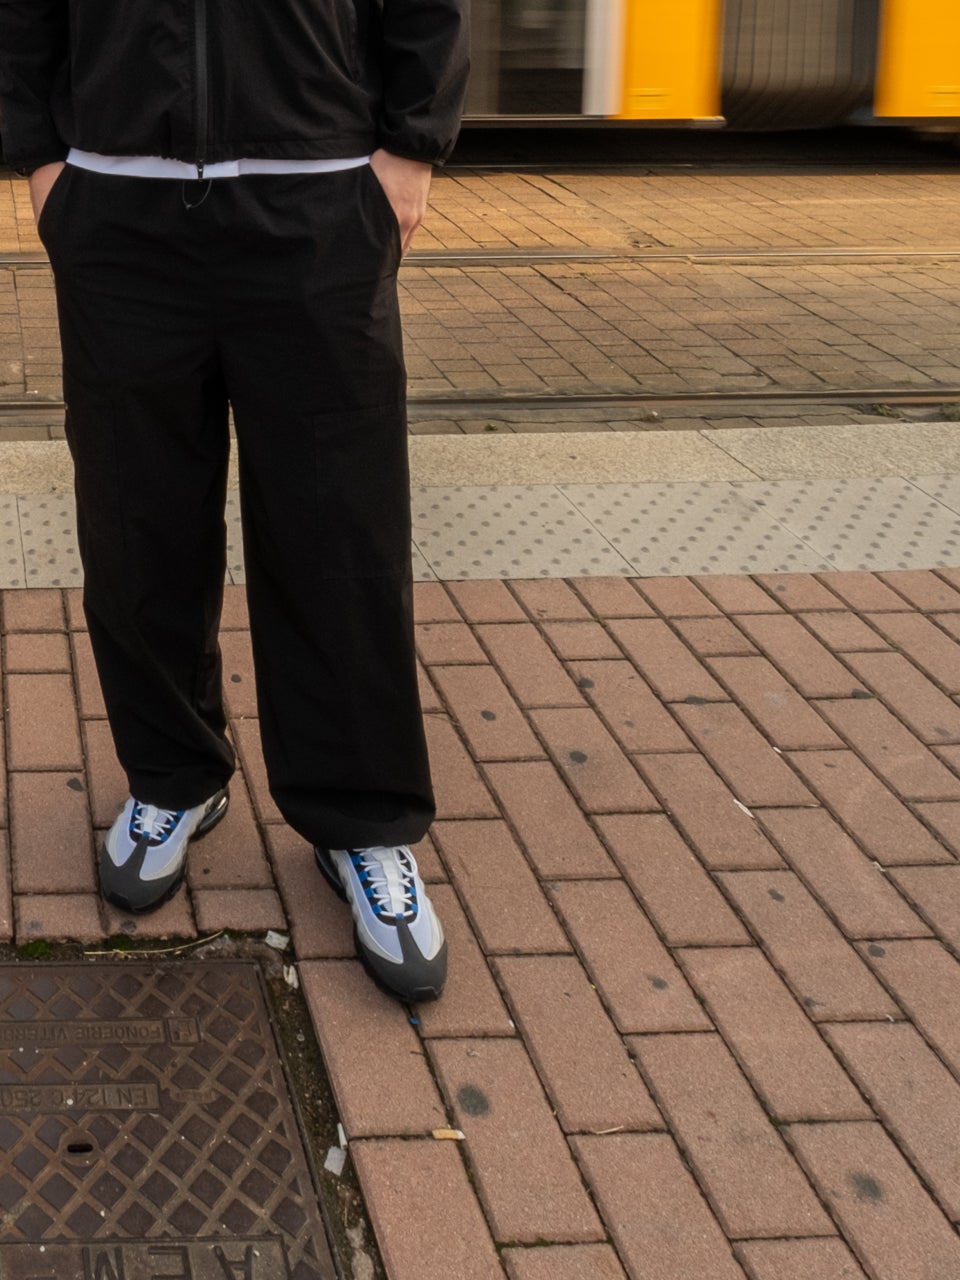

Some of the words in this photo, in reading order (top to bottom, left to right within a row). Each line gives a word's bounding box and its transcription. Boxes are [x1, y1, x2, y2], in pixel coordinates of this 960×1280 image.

[76, 1025, 161, 1041] FONDERIE
[0, 1089, 40, 1107] 250
[72, 1088, 106, 1106] 124
[117, 1088, 147, 1107] EN
